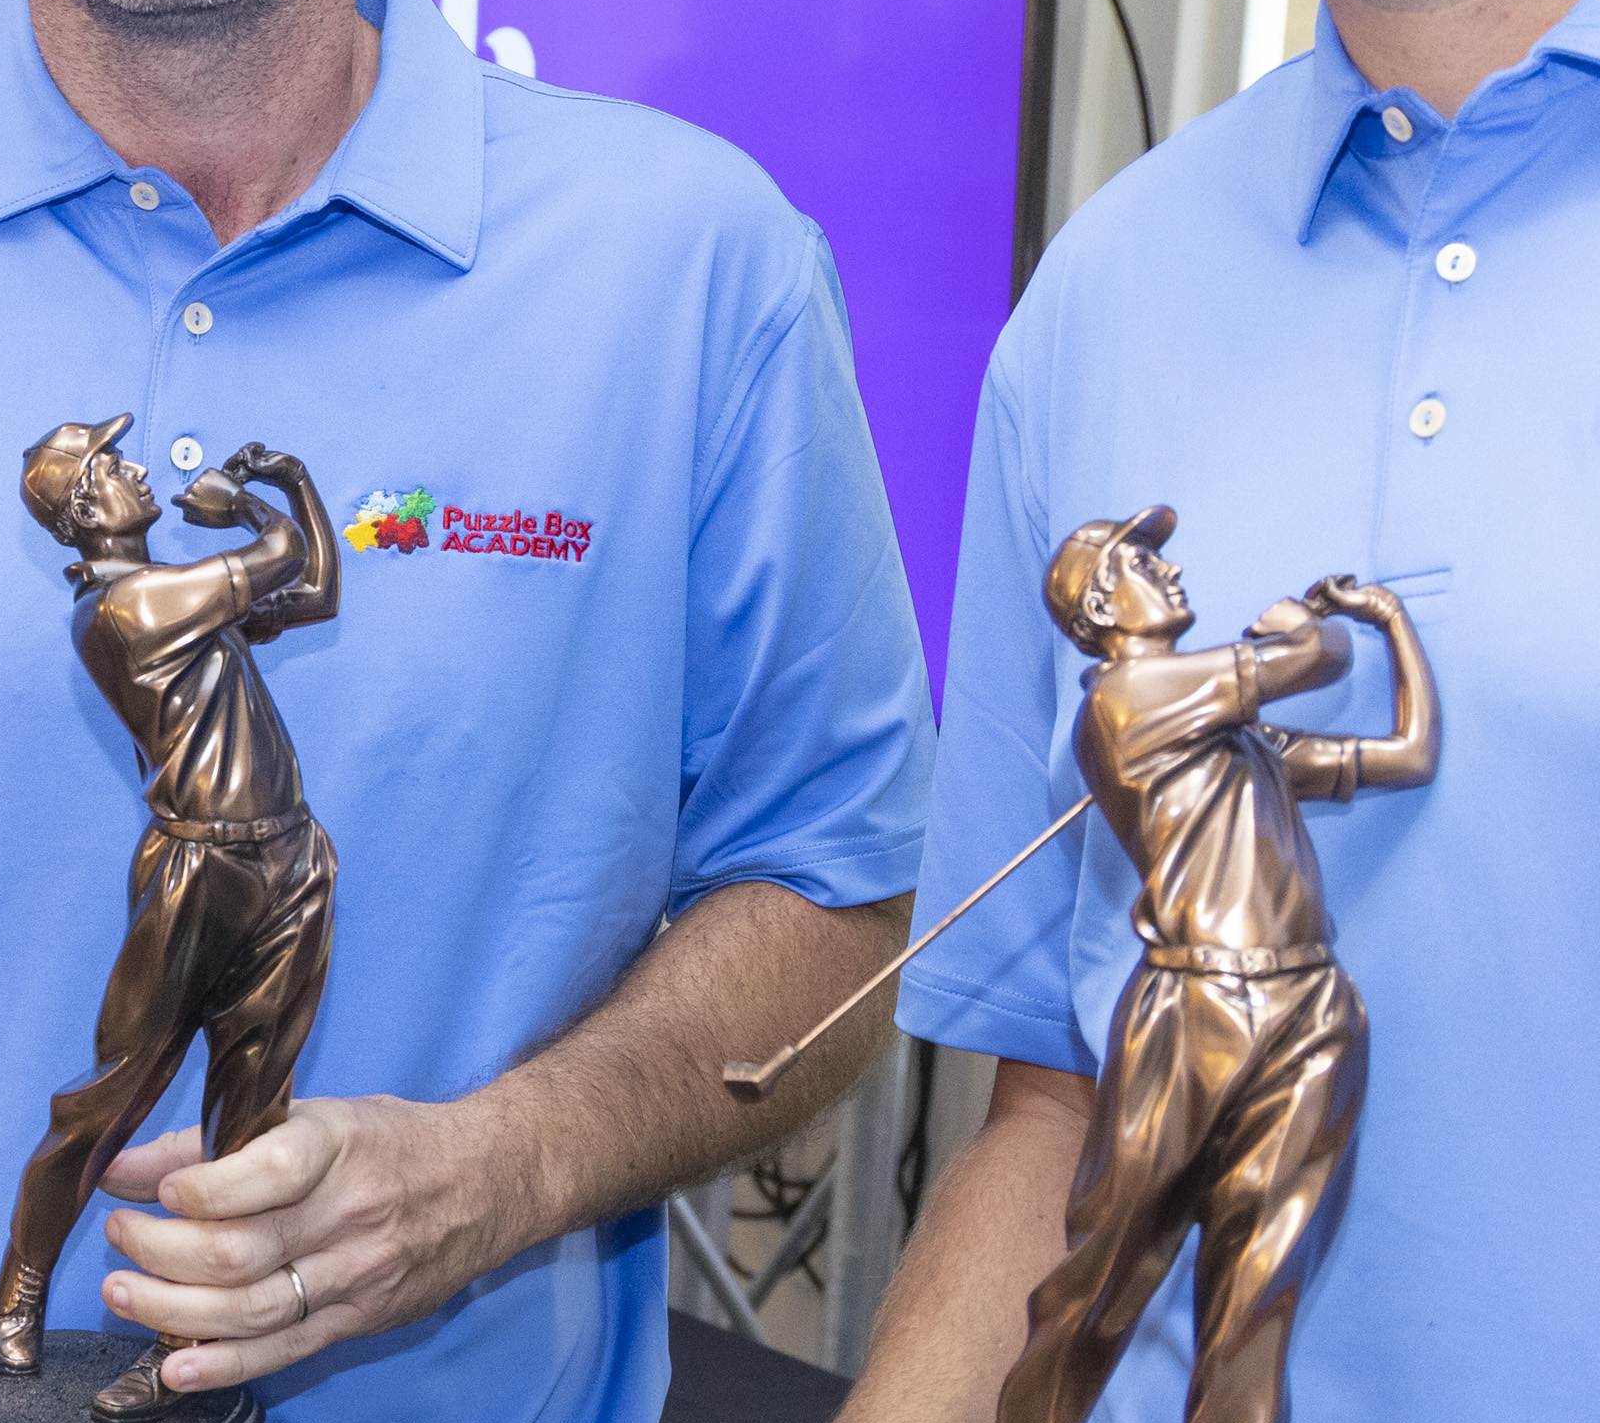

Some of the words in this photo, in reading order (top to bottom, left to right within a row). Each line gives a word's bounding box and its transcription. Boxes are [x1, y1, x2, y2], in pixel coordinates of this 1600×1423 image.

[442, 506, 537, 534] Puzzle
[544, 512, 592, 541] Box
[441, 531, 590, 562] ACADEMY
